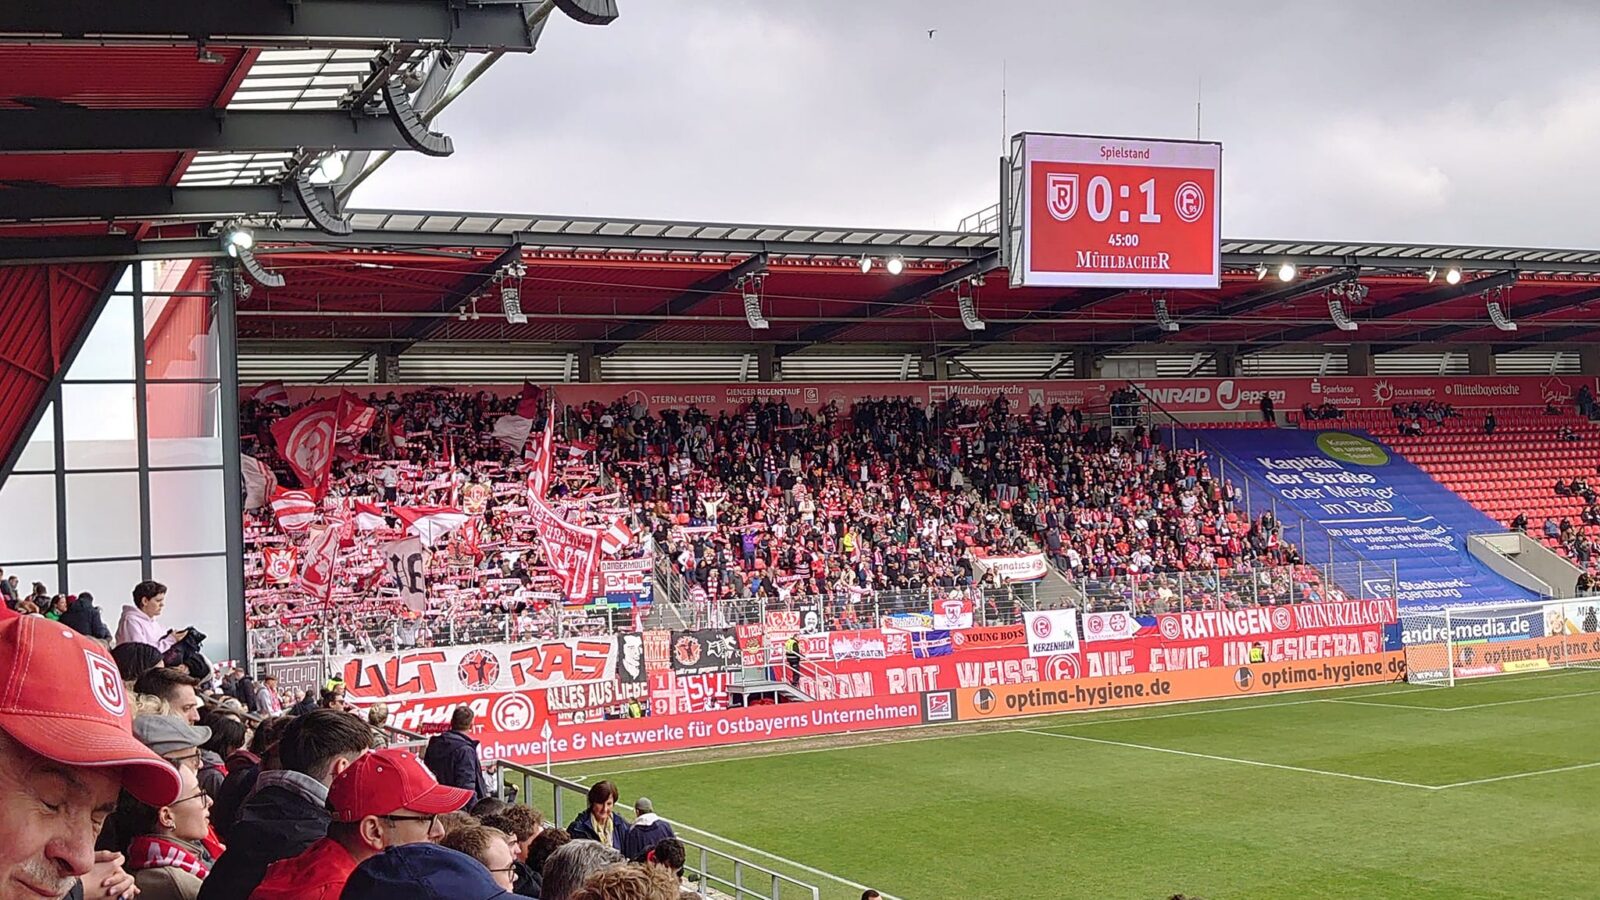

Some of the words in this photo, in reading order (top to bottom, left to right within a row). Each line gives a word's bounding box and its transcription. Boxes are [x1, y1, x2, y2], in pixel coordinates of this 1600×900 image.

[1100, 146, 1150, 160] Spielstand
[1086, 175, 1161, 223] 0:1
[1108, 234, 1138, 247] 45:00
[757, 388, 800, 396] REGENSTAUF
[949, 384, 1023, 396] Mittelbayerische
[1323, 385, 1354, 394] Sparkasse
[1454, 384, 1520, 397] Mittelbayerische
[651, 396, 677, 404] STERN
[684, 395, 716, 404] CENTER
[1323, 397, 1361, 406] Regensburg
[1257, 456, 1344, 471] Kapitän
[1265, 471, 1304, 485] der
[1301, 471, 1376, 484] Straße
[1281, 487, 1326, 500] oder
[1316, 501, 1350, 515] im
[993, 561, 1031, 571] Fanatics
[1386, 589, 1462, 600] egensburg
[1295, 602, 1396, 630] MEINERZHAGEN
[1181, 609, 1273, 640] RATINGEN
[966, 631, 1000, 642] YOUNG
[1001, 630, 1025, 639] BOYS
[811, 639, 826, 652] 10
[1033, 641, 1075, 652] KERZENHEIM
[273, 666, 316, 684] VECCHIO
[956, 658, 1040, 688] WEISS
[1262, 657, 1407, 688] optima-hygiene.de
[547, 684, 587, 710] ALLES
[589, 681, 613, 706] AUS
[1006, 680, 1171, 711] optima-hygiene.de
[572, 734, 587, 749] &
[591, 724, 683, 747] Netzwerke
[687, 721, 712, 737] für
[717, 712, 808, 734] Ostbayerns
[812, 704, 918, 725] Unternehmen
